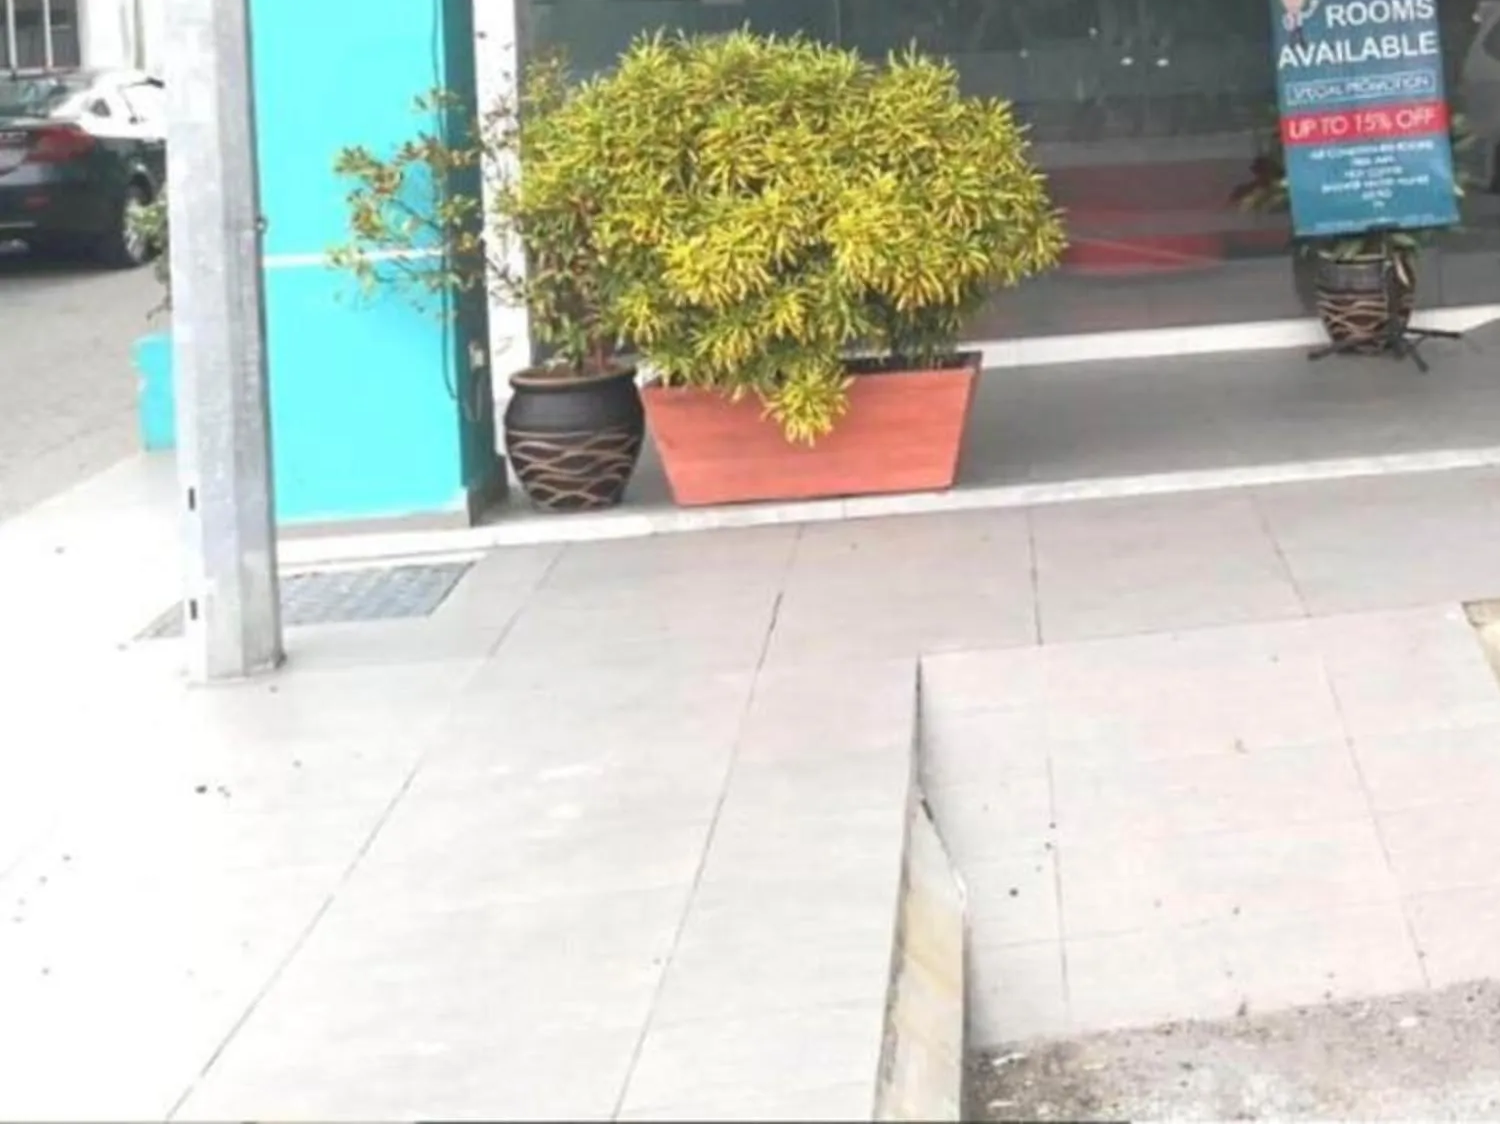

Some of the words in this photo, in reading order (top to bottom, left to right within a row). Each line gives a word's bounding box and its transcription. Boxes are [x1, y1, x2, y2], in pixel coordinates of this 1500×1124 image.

[1278, 30, 1438, 70] AVAILABLE
[1346, 69, 1430, 94] PROMOTION
[1288, 118, 1317, 140] UP
[1319, 115, 1349, 136] TO
[1354, 108, 1392, 133] 15%
[1395, 104, 1437, 128] OFF
